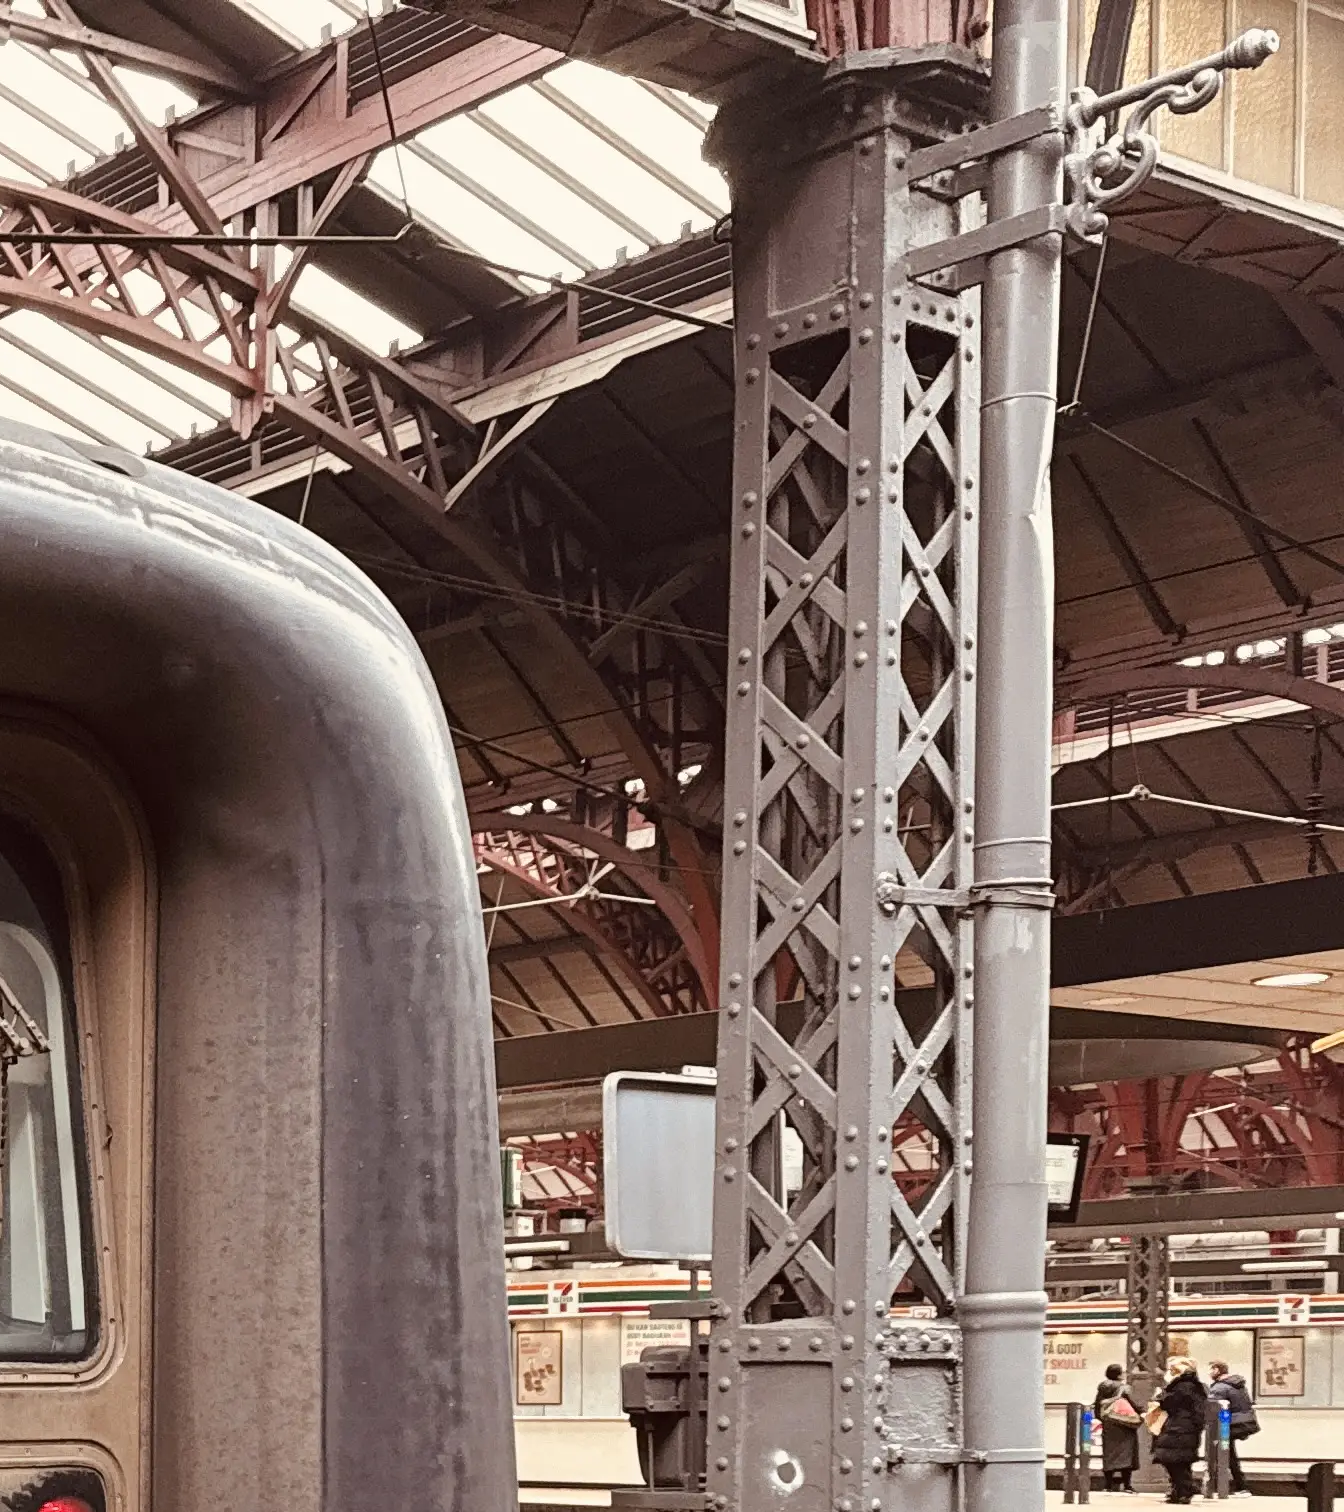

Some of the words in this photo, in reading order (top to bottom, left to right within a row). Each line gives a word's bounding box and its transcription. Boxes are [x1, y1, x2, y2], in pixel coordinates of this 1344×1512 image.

[1284, 1298, 1304, 1321] 7
[1057, 1343, 1082, 1354] GODT
[1051, 1359, 1087, 1370] SKULLE
